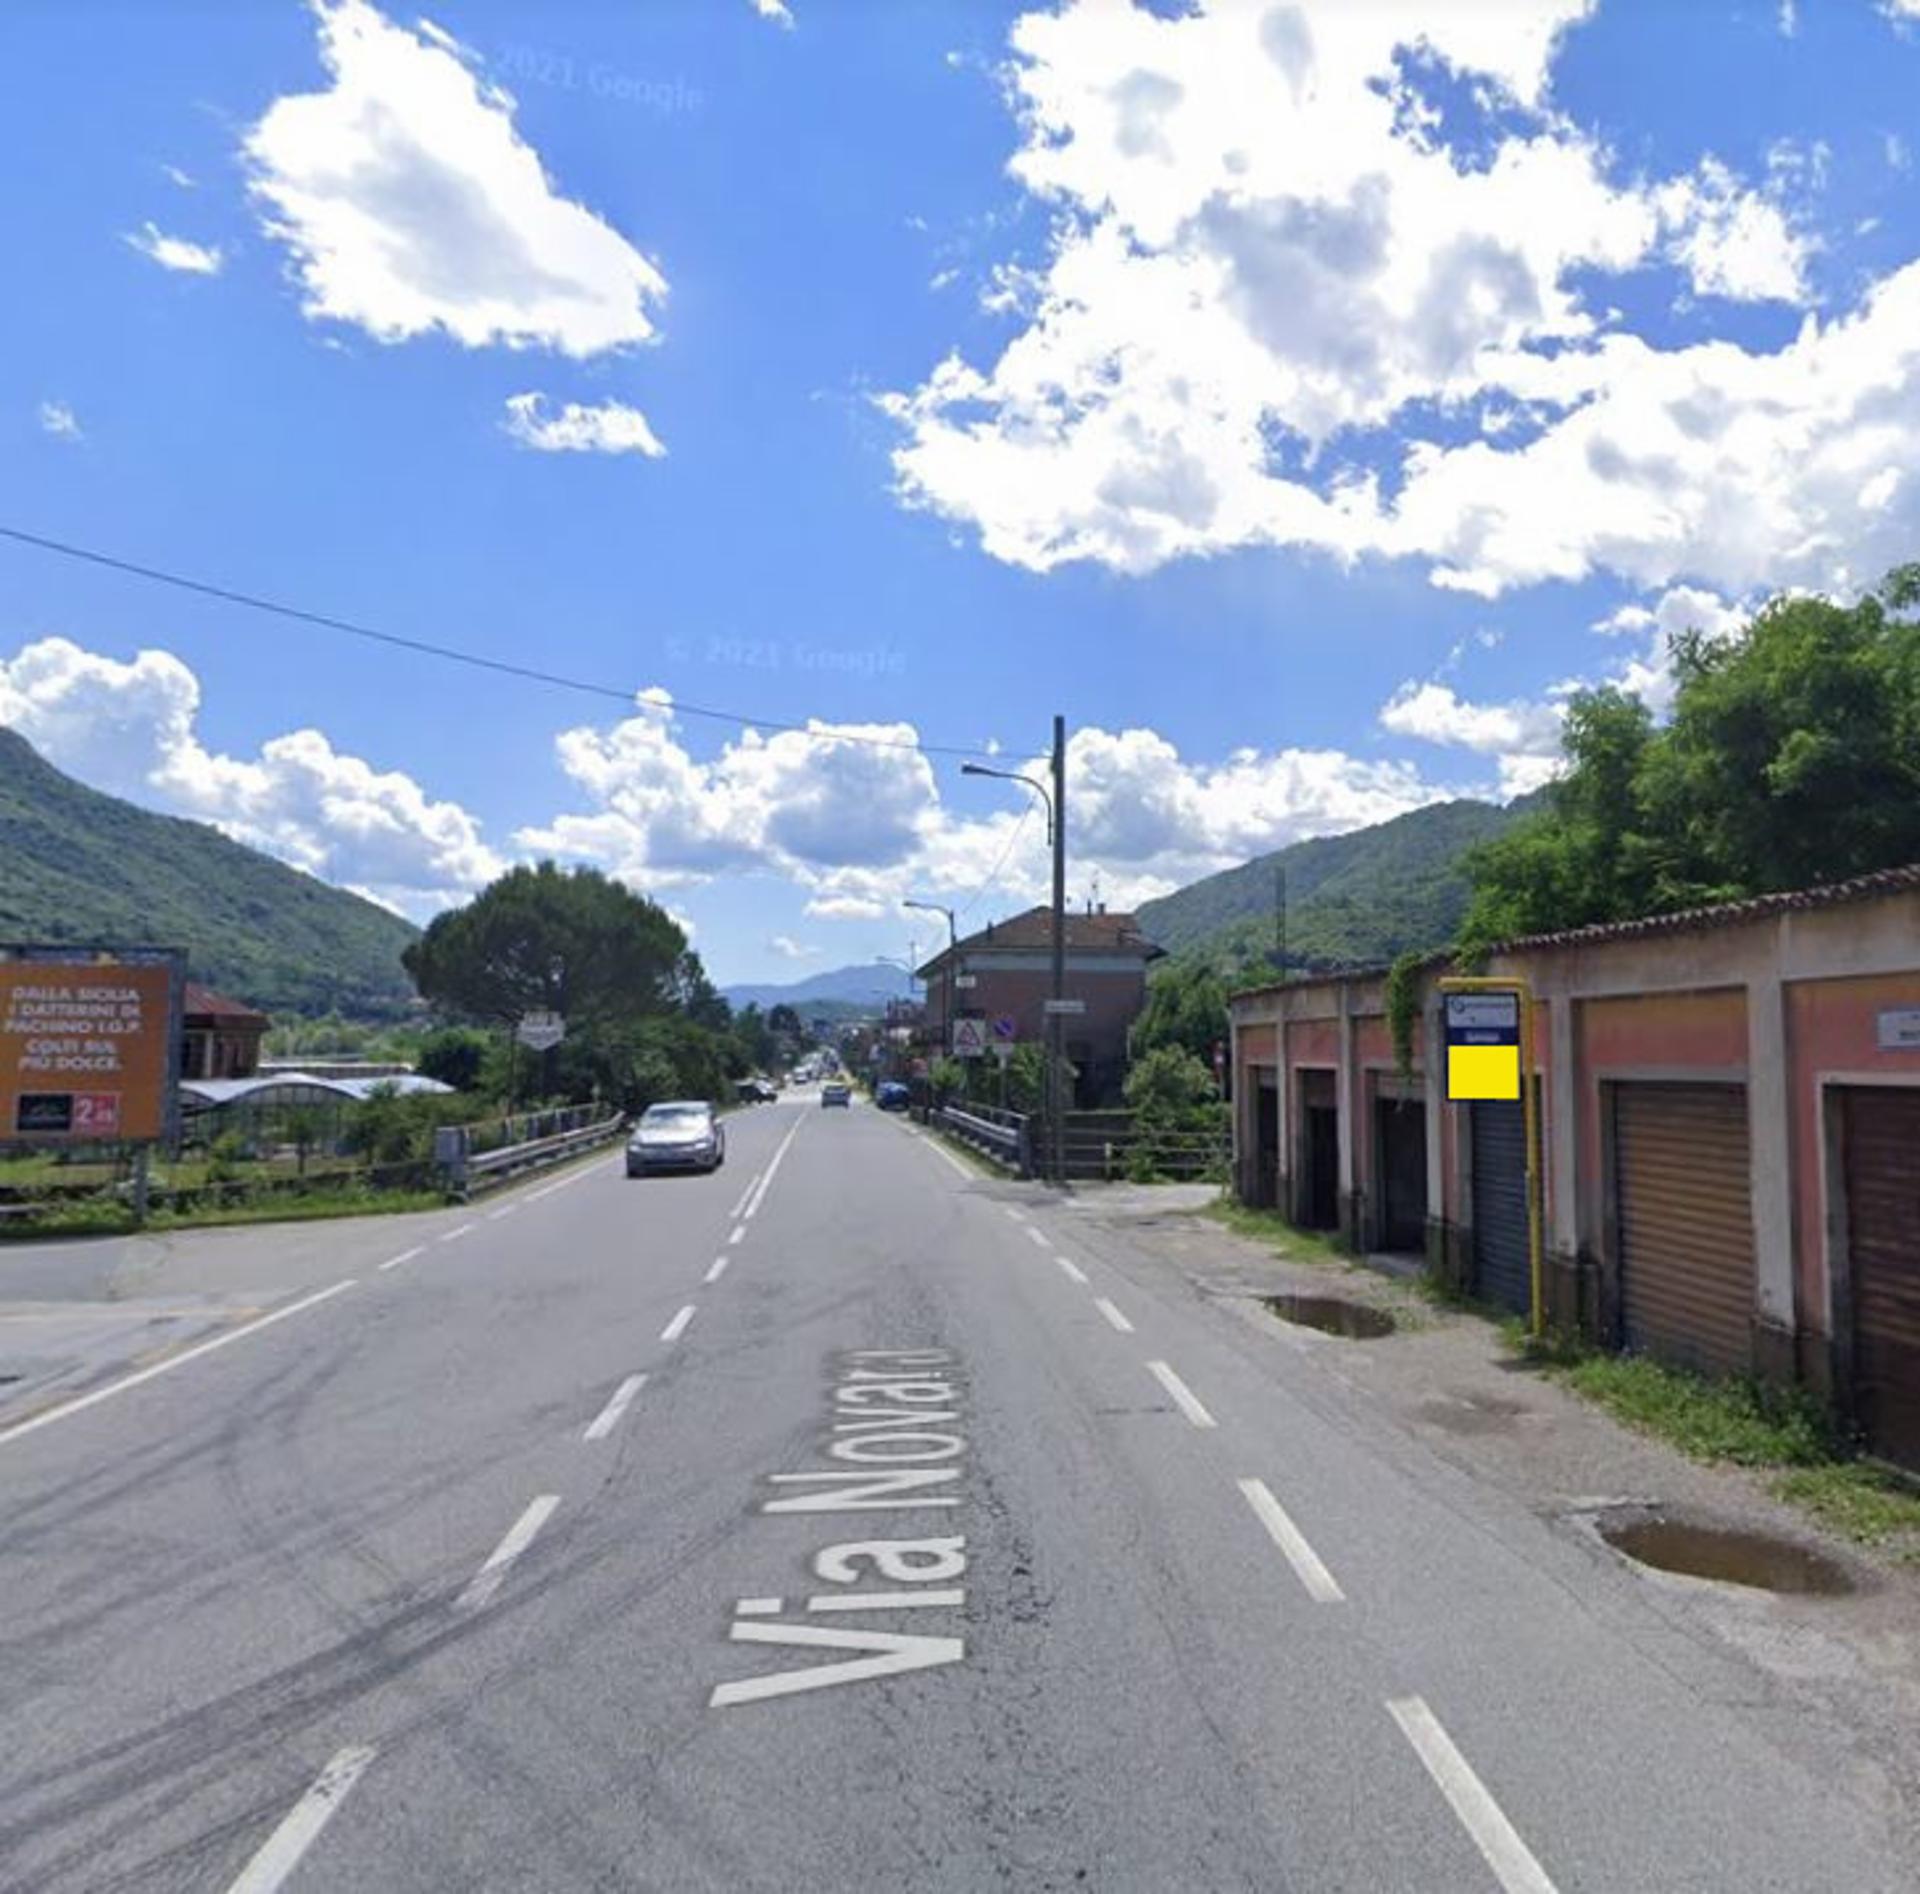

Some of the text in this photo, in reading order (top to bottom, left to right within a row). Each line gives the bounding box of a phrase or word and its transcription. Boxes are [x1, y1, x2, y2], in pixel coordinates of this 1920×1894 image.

[12, 986, 140, 1002] DALLA SICILIA
[21, 1002, 115, 1017] DATTERINI
[4, 1018, 94, 1034] PACHINO
